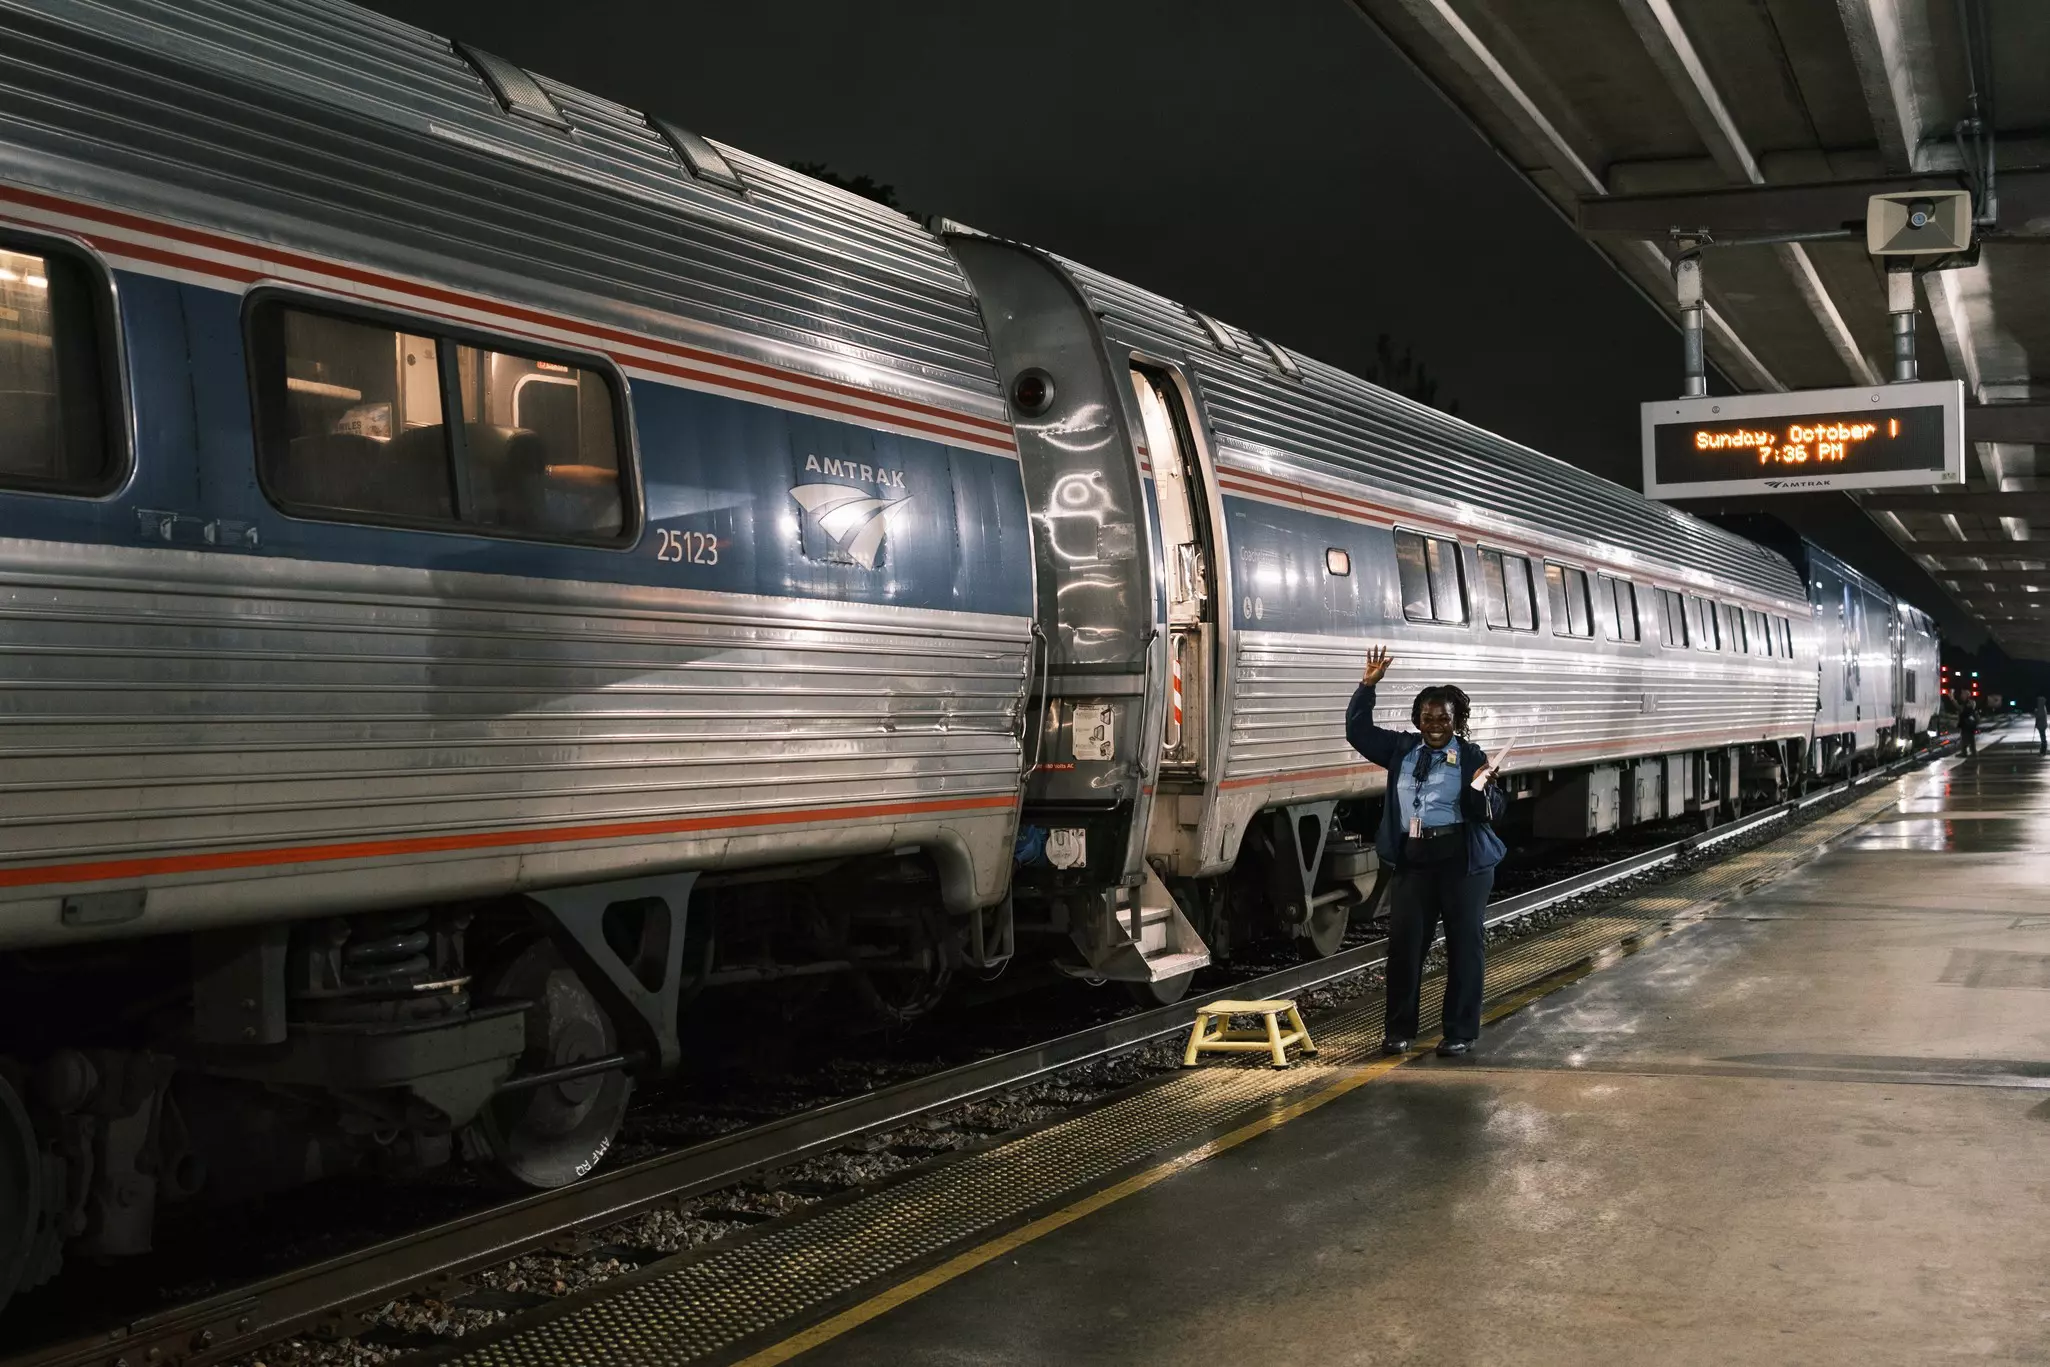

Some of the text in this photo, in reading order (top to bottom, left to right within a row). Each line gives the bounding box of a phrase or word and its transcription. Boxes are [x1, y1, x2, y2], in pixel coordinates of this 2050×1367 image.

[1696, 429, 1776, 449] Sunday,
[1790, 421, 1876, 442] October
[1759, 442, 1844, 465] 7:36 PM
[805, 453, 906, 489] AMTRAK
[1782, 480, 1831, 488] AMTRAK
[656, 528, 718, 566] 25123
